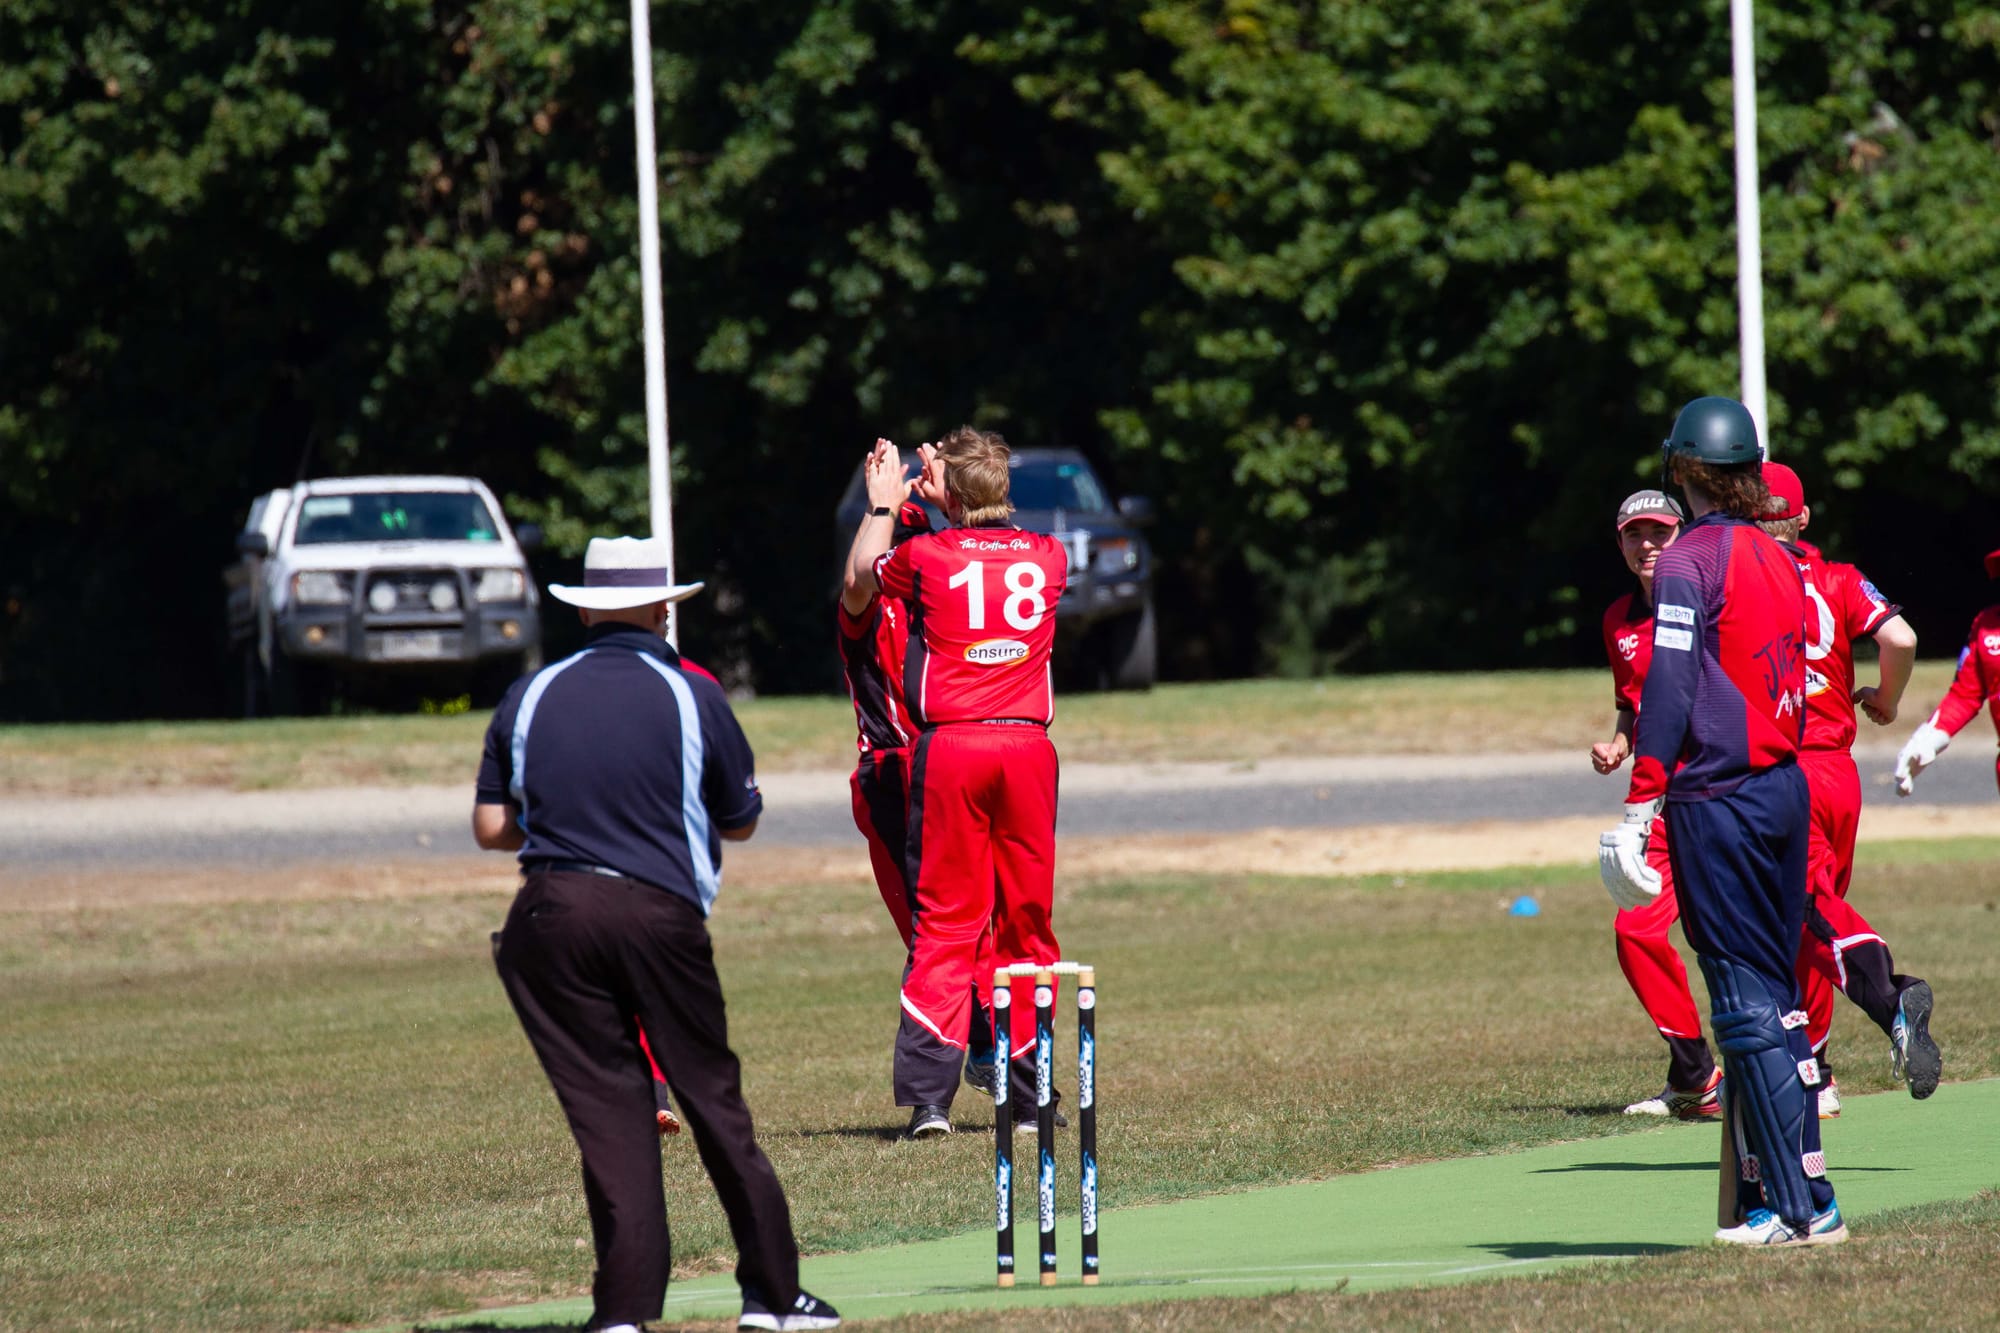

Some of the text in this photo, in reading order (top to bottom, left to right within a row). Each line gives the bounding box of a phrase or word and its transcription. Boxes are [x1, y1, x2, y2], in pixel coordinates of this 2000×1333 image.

[959, 538, 977, 549] The
[979, 541, 1008, 551] Coffee
[949, 561, 1046, 631] 18
[968, 647, 1026, 659] ensure
